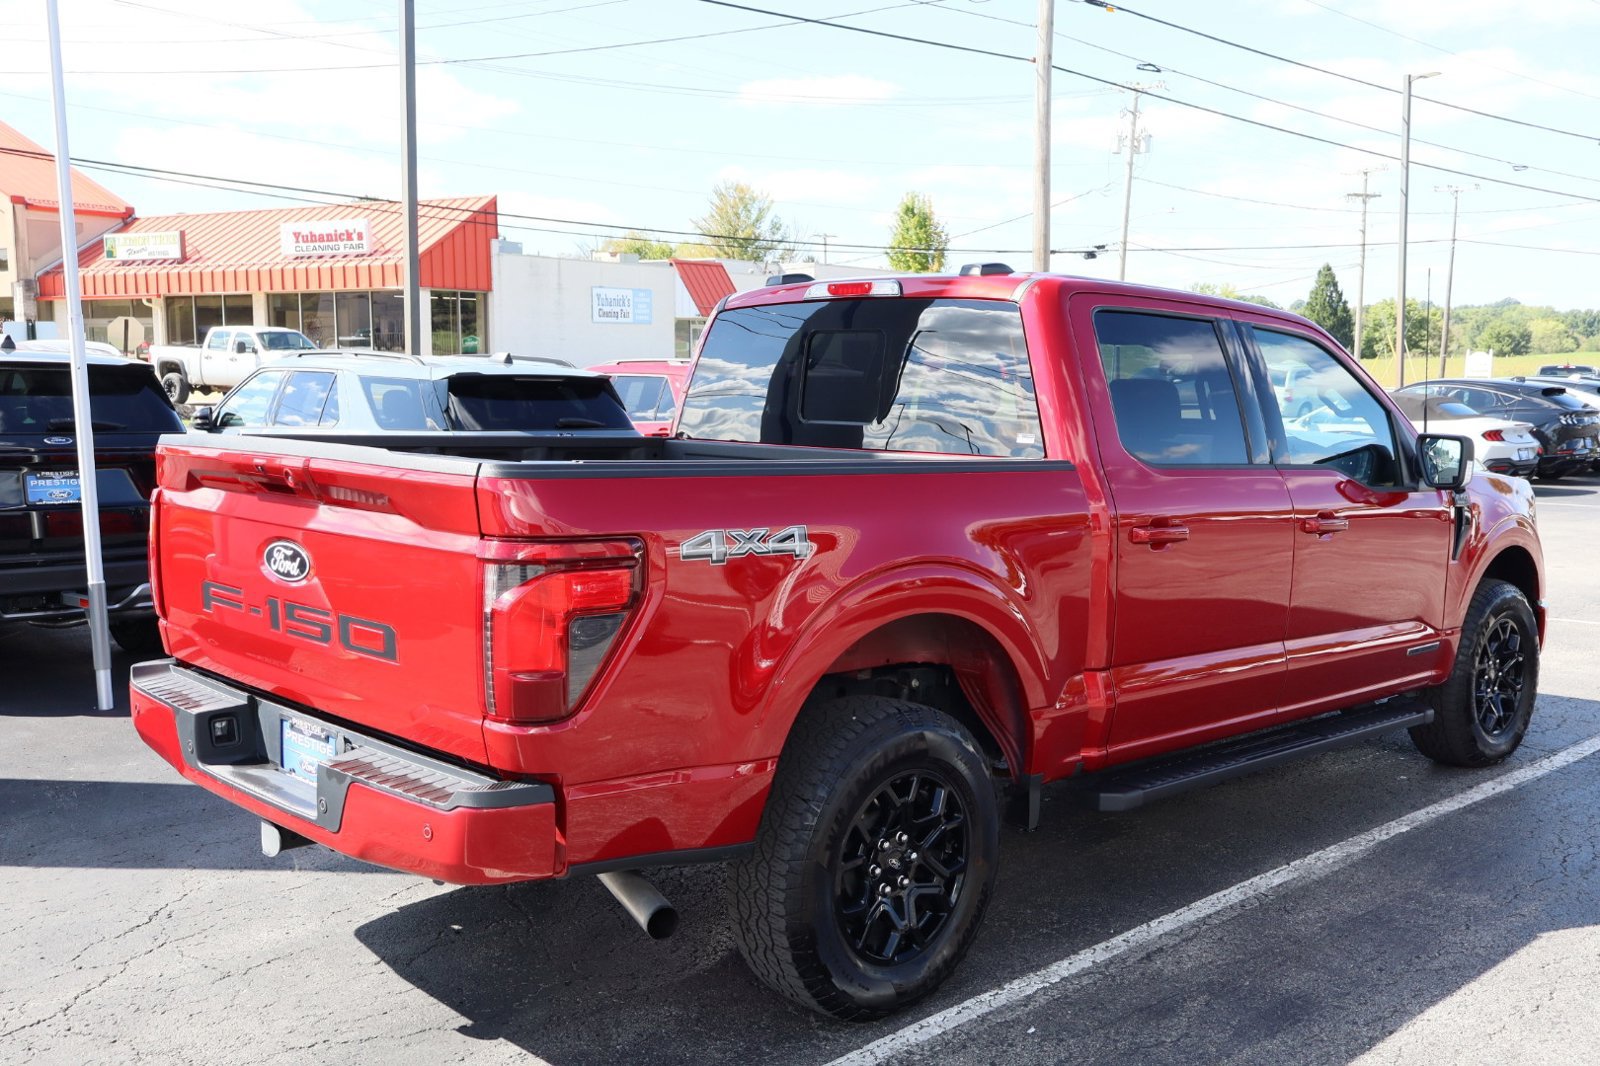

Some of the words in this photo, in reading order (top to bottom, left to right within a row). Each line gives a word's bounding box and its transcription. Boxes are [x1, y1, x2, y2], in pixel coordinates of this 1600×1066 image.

[293, 228, 364, 243] Yuhanick's
[294, 244, 340, 253] CLEANING
[343, 243, 365, 251] FAIR
[596, 292, 631, 308] Yuhanick's
[30, 479, 81, 487] PRESTIG
[270, 546, 301, 577] Ford
[202, 580, 400, 665] F-150
[285, 731, 334, 757] PRESTIGE
